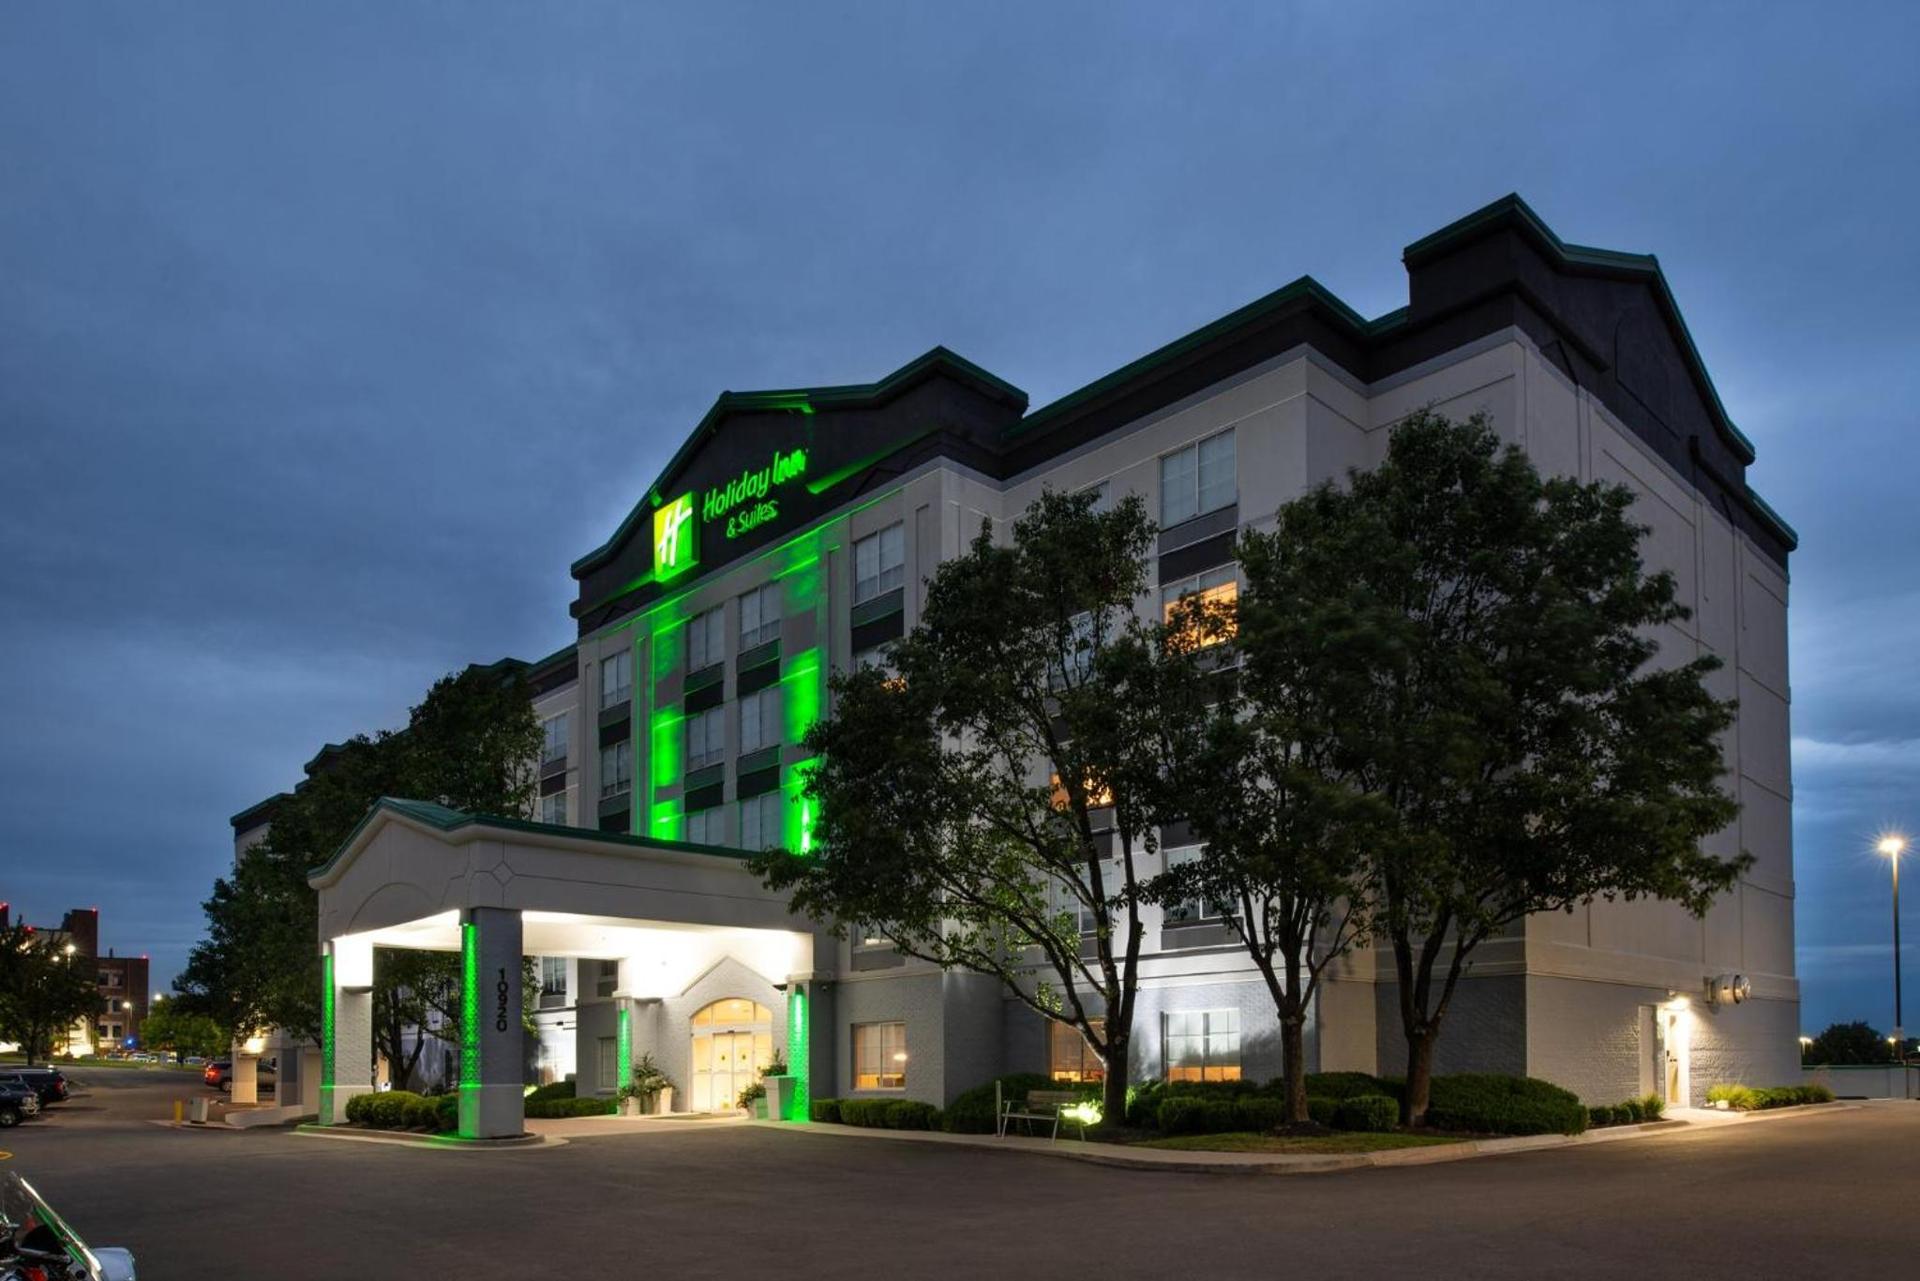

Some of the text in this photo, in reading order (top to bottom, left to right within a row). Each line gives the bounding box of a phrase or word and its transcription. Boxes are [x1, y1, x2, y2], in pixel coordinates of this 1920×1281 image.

[703, 449, 807, 522] Holiday Inn
[726, 500, 779, 539] & Suites
[496, 967, 508, 1032] 10920
